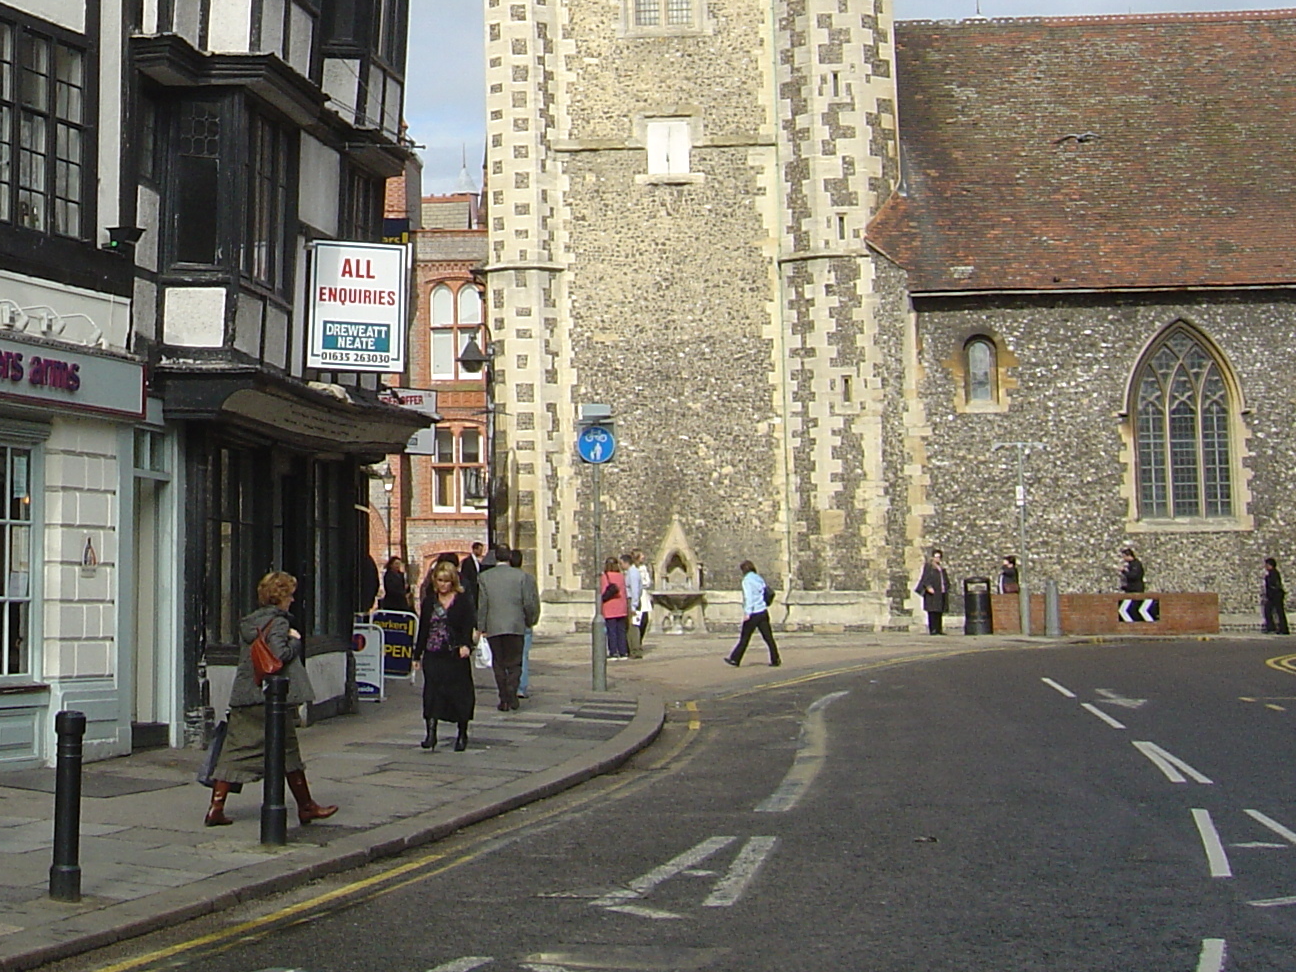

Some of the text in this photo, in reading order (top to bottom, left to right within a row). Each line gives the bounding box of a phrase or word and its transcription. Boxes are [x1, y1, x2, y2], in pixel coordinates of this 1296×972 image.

[341, 258, 376, 279] ALL
[318, 286, 396, 306] ENQUIRIES
[325, 323, 388, 339] DREWEATT
[337, 336, 376, 350] NEATE
[321, 351, 390, 364] 01635 263030
[28, 356, 81, 392] arms
[383, 644, 412, 659] PEN
